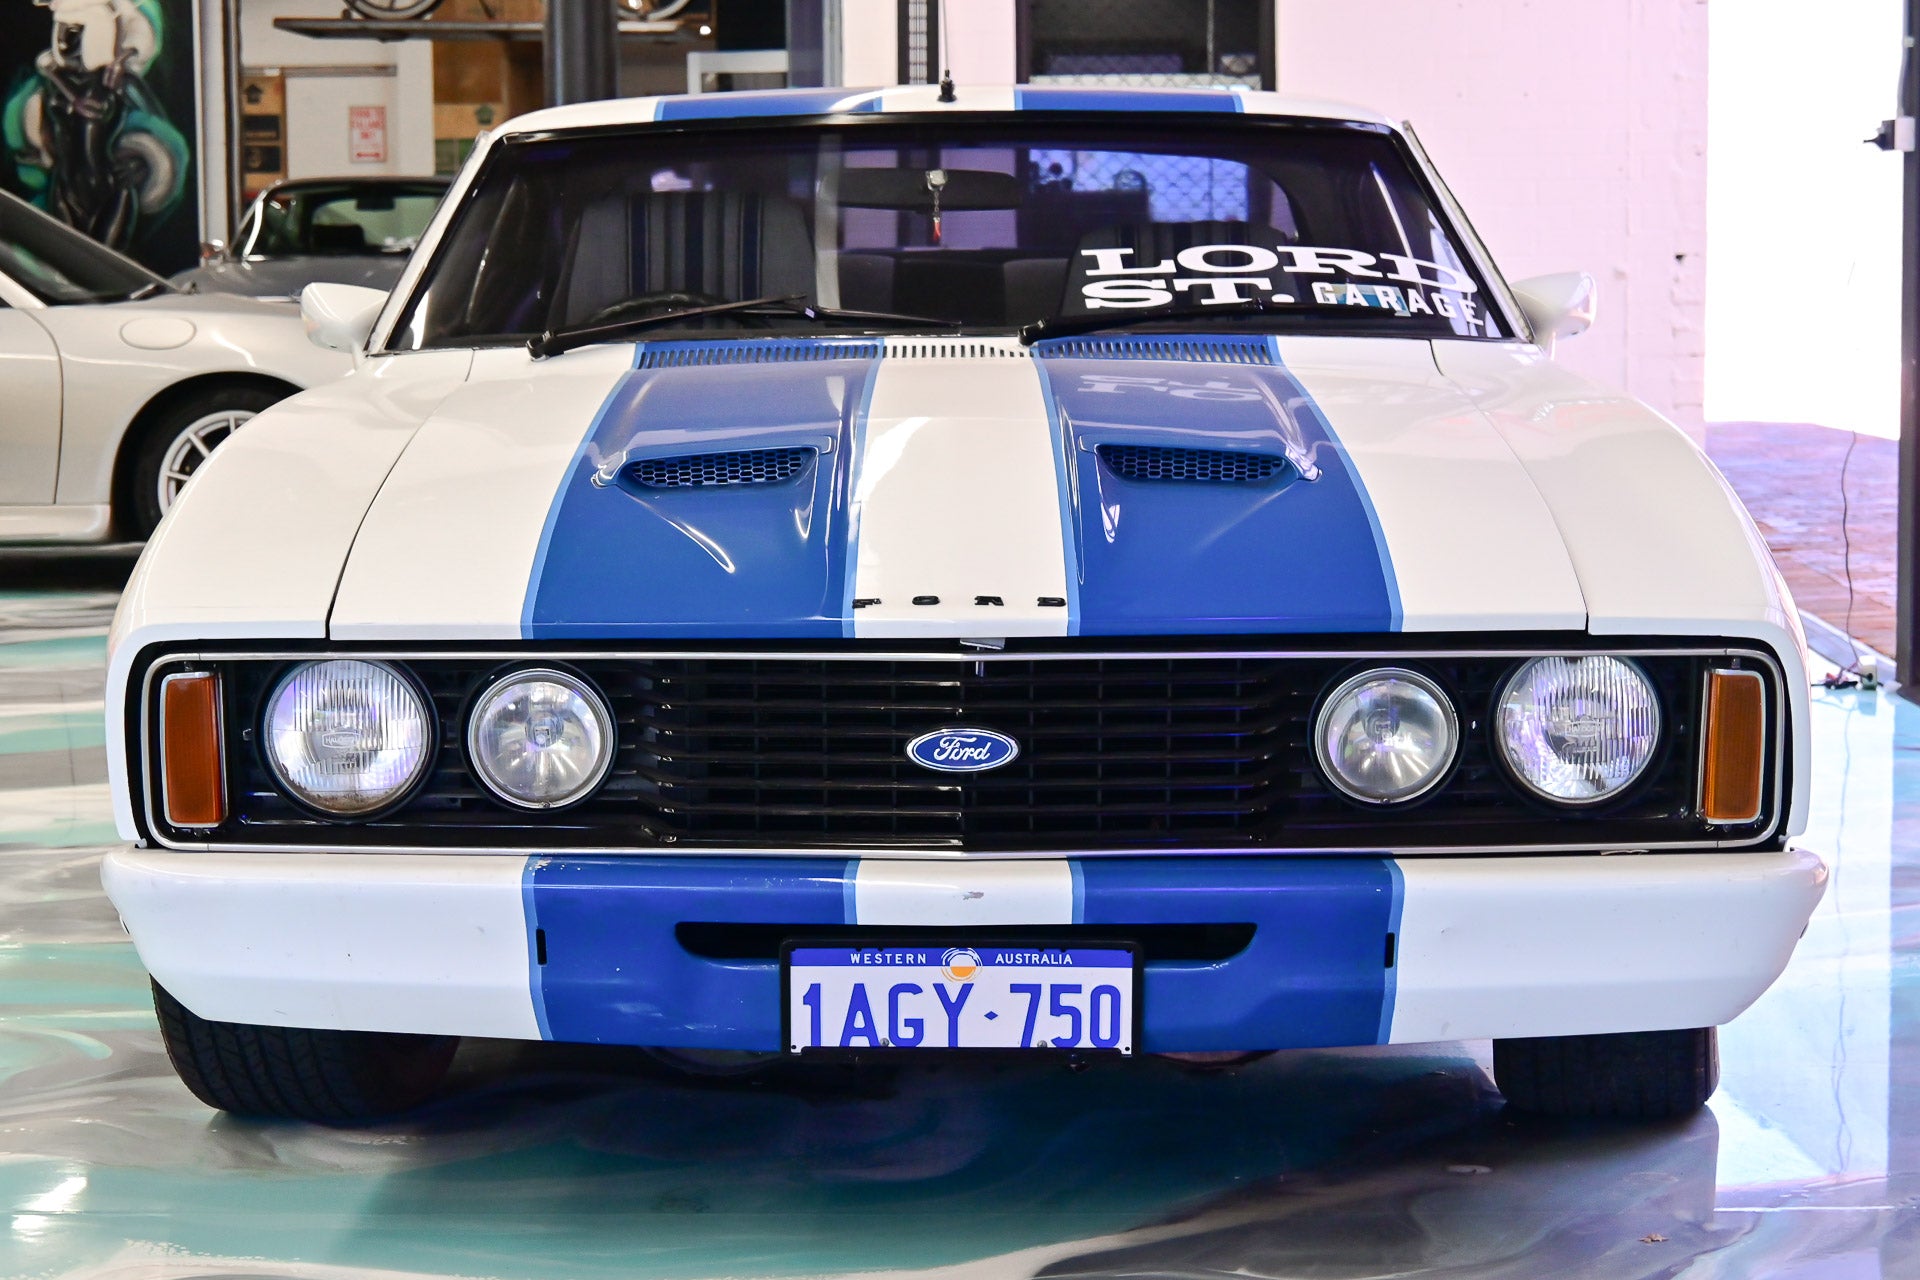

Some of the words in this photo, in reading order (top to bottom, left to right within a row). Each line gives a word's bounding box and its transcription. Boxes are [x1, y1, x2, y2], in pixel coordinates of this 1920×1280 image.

[1081, 244, 1478, 294] LORD
[1082, 277, 1295, 309] ST.
[1311, 282, 1484, 326] GARAGE
[852, 595, 1067, 609] FORD
[933, 736, 991, 761] Ford
[850, 953, 926, 964] WESTERN
[995, 953, 1073, 965] AUSTRALIA
